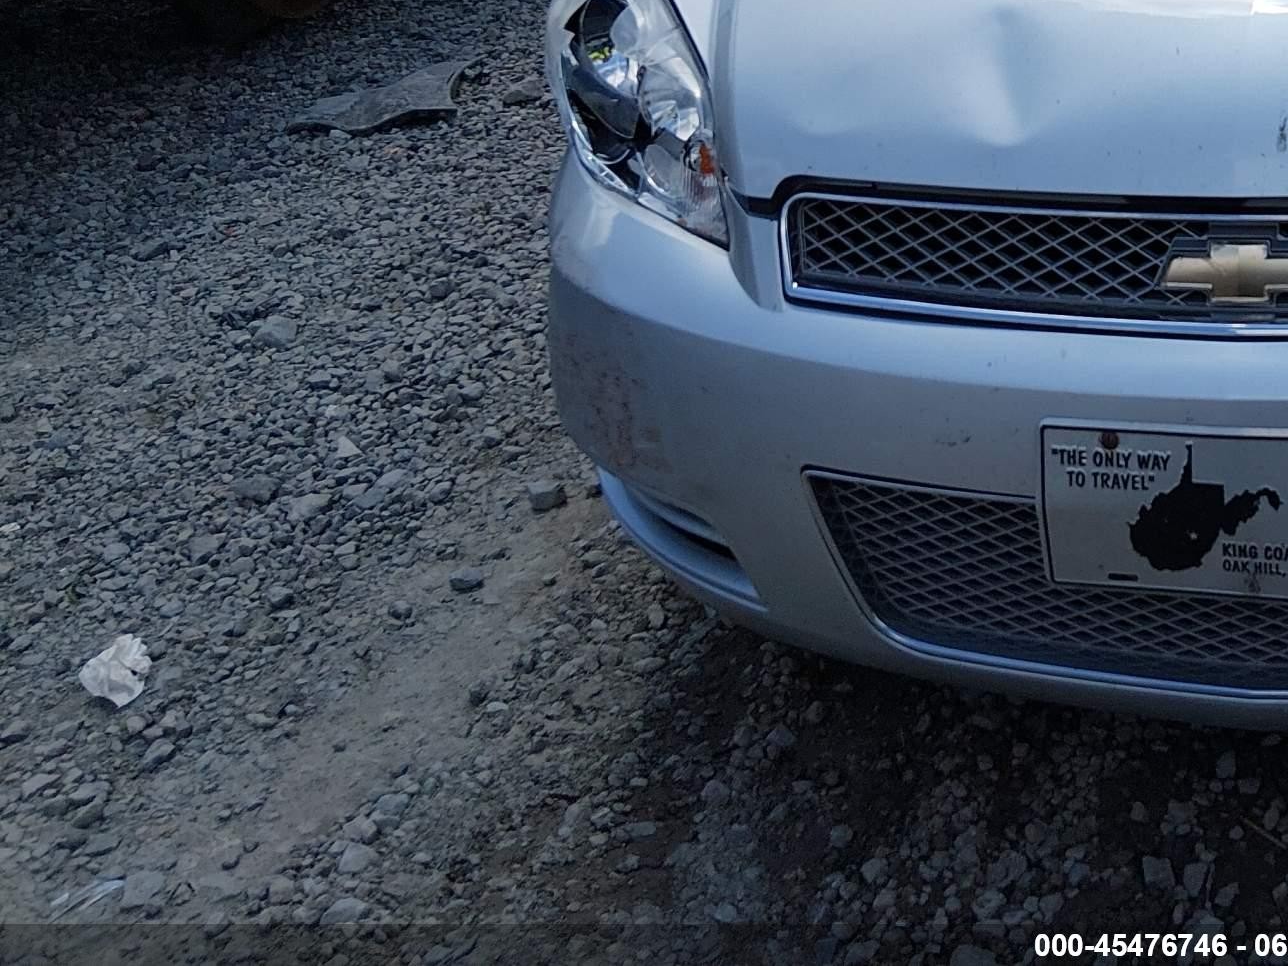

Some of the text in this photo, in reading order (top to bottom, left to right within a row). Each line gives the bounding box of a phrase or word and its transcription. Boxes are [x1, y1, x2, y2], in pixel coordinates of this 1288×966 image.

[1051, 448, 1171, 471] "THE ONLY WAY
[1066, 471, 1155, 491] TO TRAVEL"
[1222, 543, 1259, 560] KING
[1222, 559, 1250, 573] OAK
[1254, 562, 1287, 579] HILL,
